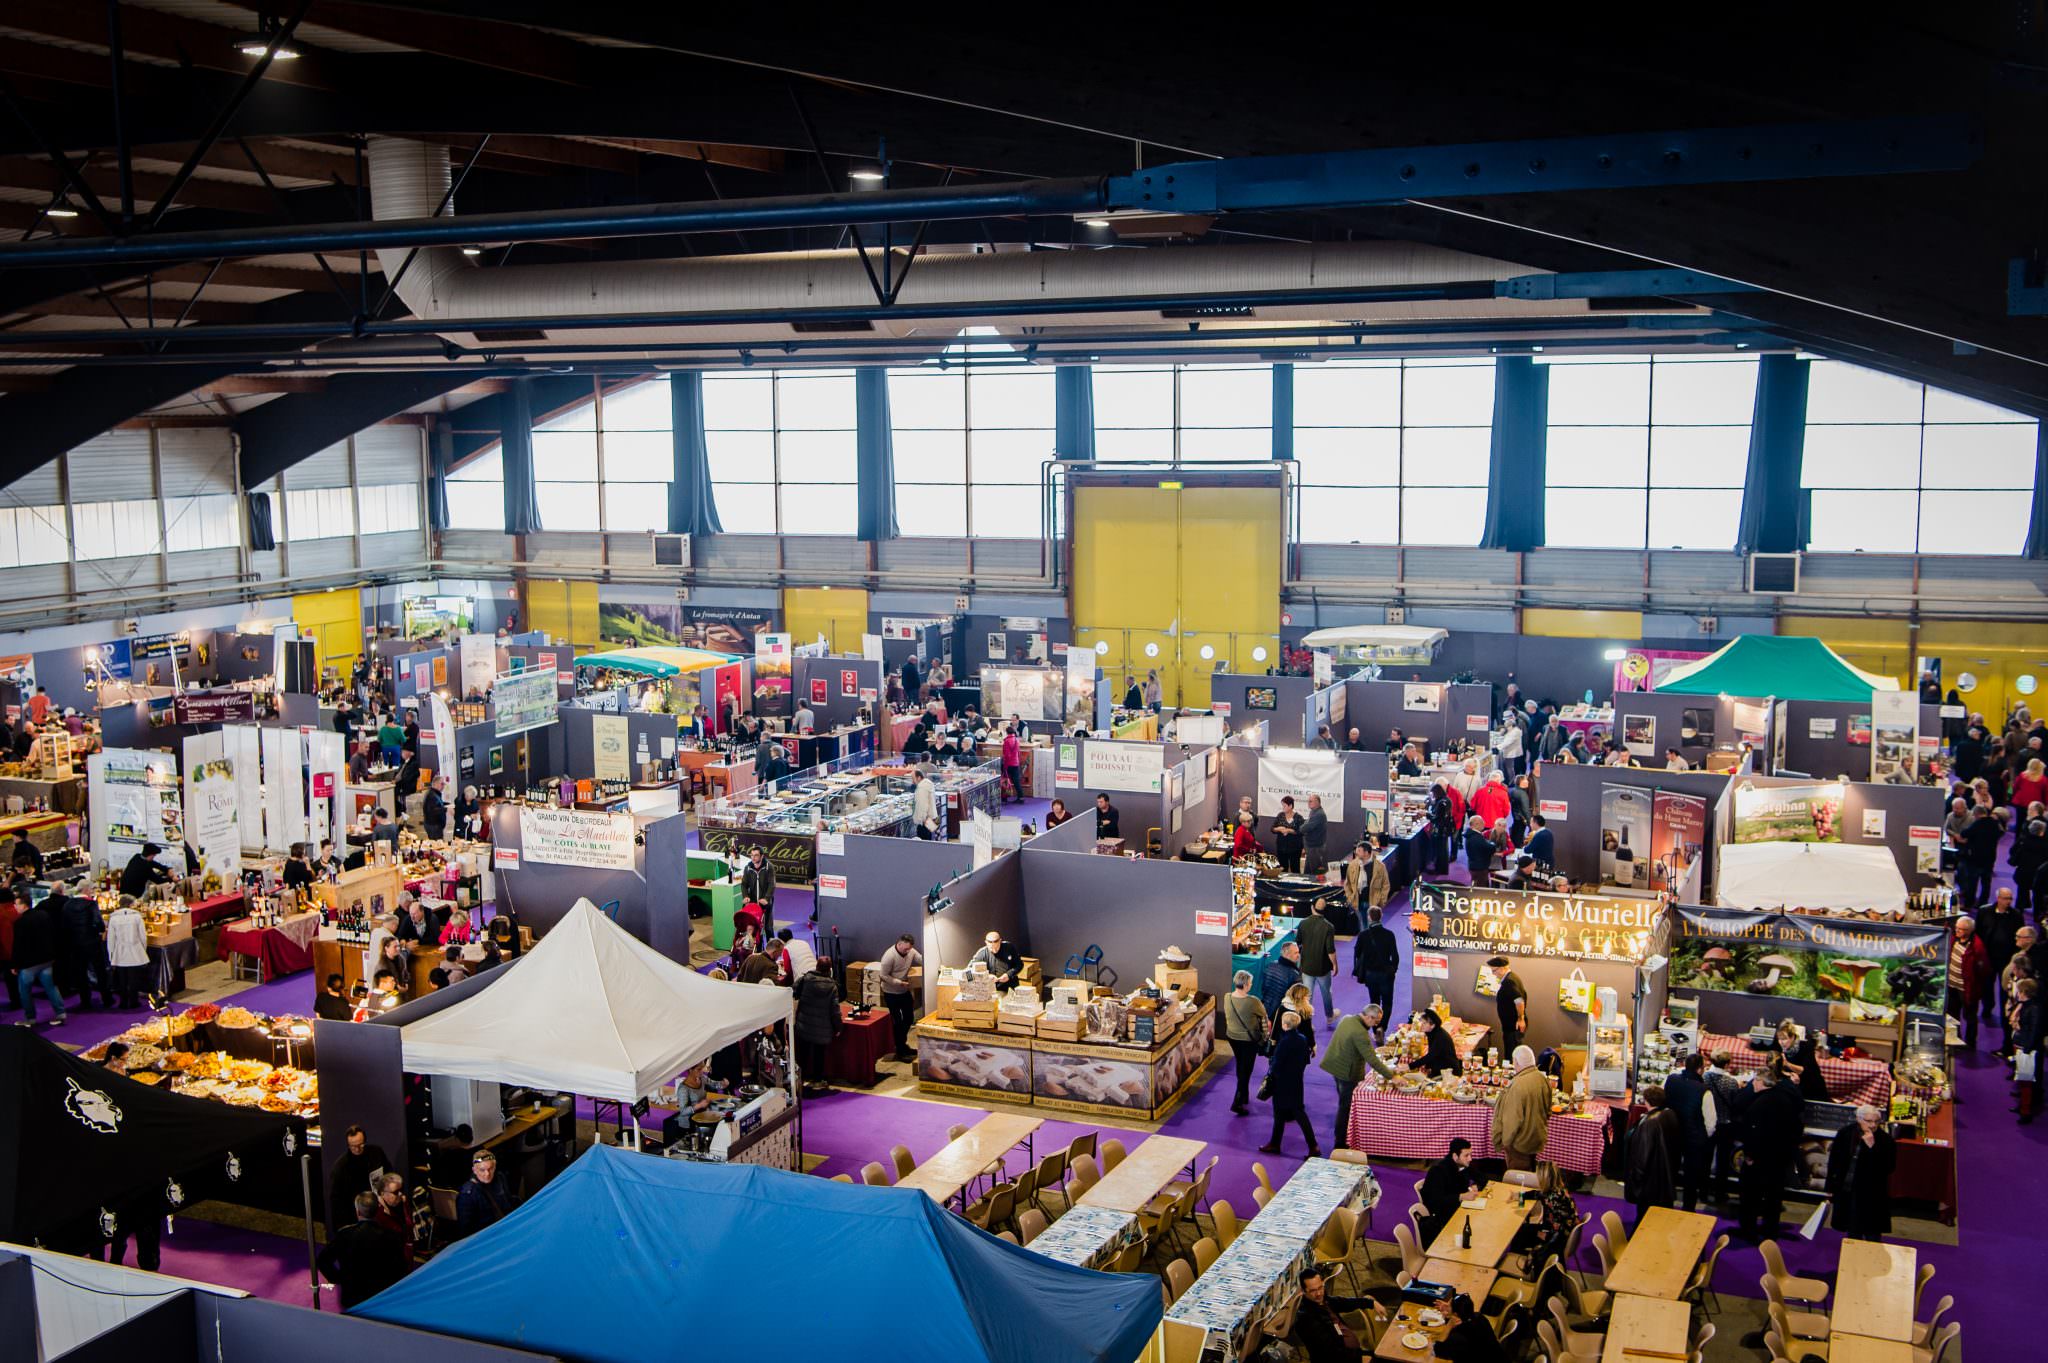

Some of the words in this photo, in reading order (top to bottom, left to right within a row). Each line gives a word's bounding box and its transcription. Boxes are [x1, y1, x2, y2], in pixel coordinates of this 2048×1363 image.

[537, 813, 557, 822] GRAND
[572, 816, 580, 824] DE
[580, 817, 612, 826] BORDEAUX
[1414, 887, 1434, 911] la
[1442, 891, 1516, 917] Ferme
[1524, 895, 1554, 921] de
[1562, 899, 1662, 928] Murielle
[1442, 917, 1478, 938] FOIE
[1482, 920, 1520, 940] GRAS
[1682, 912, 1774, 940] L'ÉCHOPPE
[1780, 927, 1806, 941] DES
[1811, 923, 1938, 960] CHAMPIGNONS
[1416, 936, 1438, 947] 32400
[1439, 938, 1493, 951] SAINT-MONT
[1497, 943, 1508, 951] 06
[1509, 943, 1520, 952] 87
[1521, 944, 1532, 954] 07
[1545, 947, 1555, 955] 25
